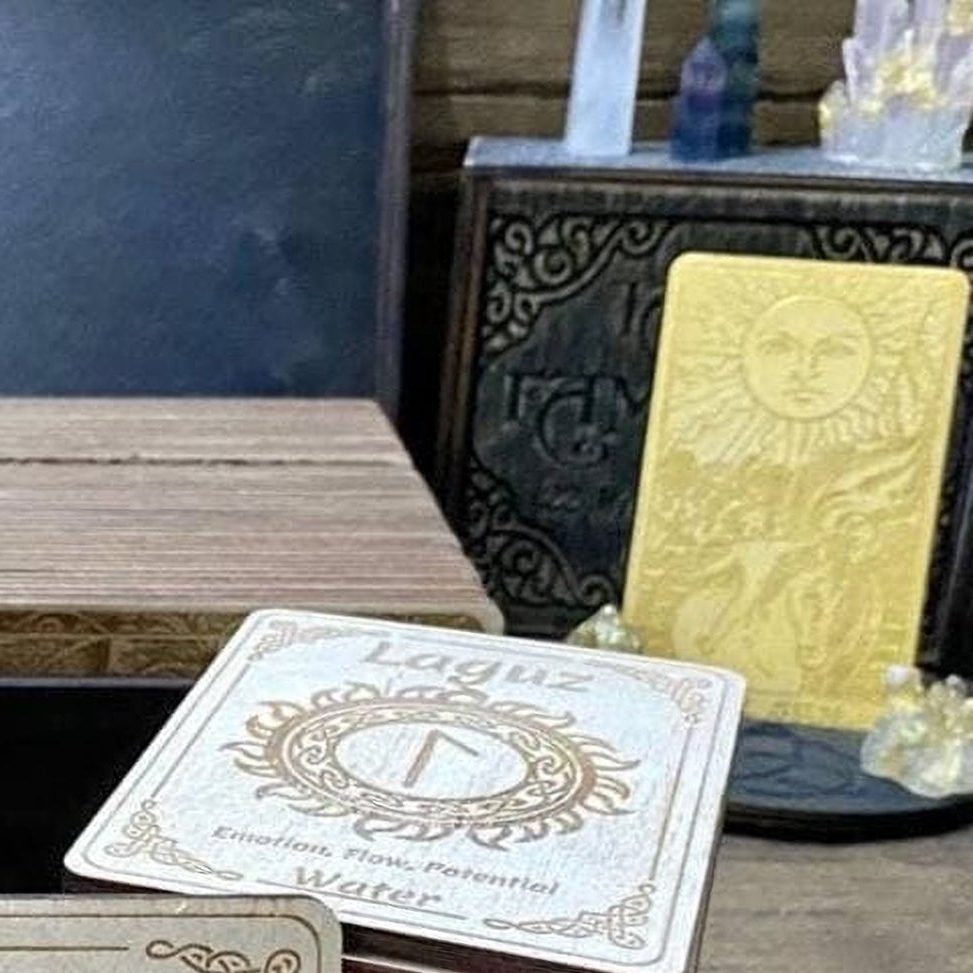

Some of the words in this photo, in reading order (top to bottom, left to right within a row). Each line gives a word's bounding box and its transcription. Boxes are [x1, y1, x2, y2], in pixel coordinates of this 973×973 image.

[364, 641, 594, 693] Laguz
[293, 866, 443, 906] Water
[419, 860, 560, 896] Potential
